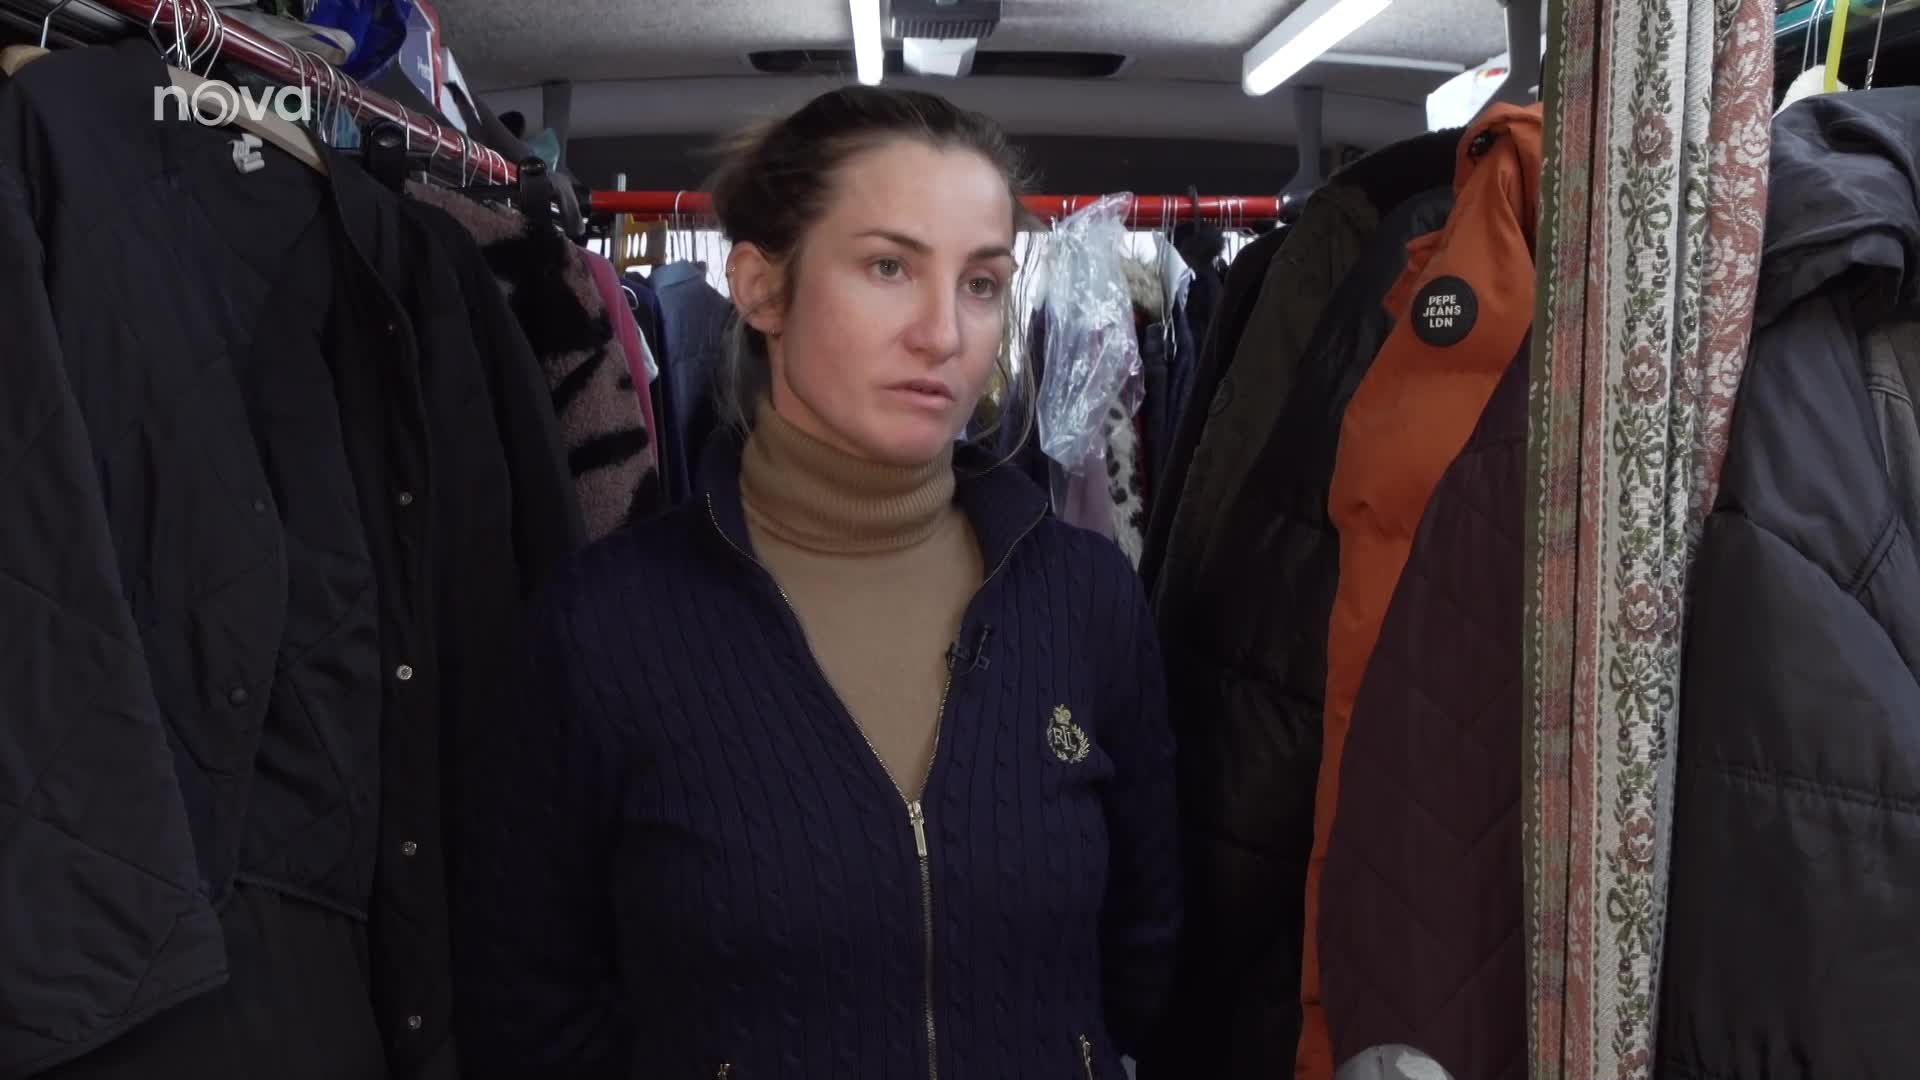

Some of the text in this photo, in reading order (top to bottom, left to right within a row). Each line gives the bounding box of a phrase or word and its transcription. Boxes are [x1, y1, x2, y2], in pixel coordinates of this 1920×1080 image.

[1428, 294, 1457, 306] PEPE
[1422, 305, 1461, 317] JEANS
[1429, 317, 1453, 328] LDN
